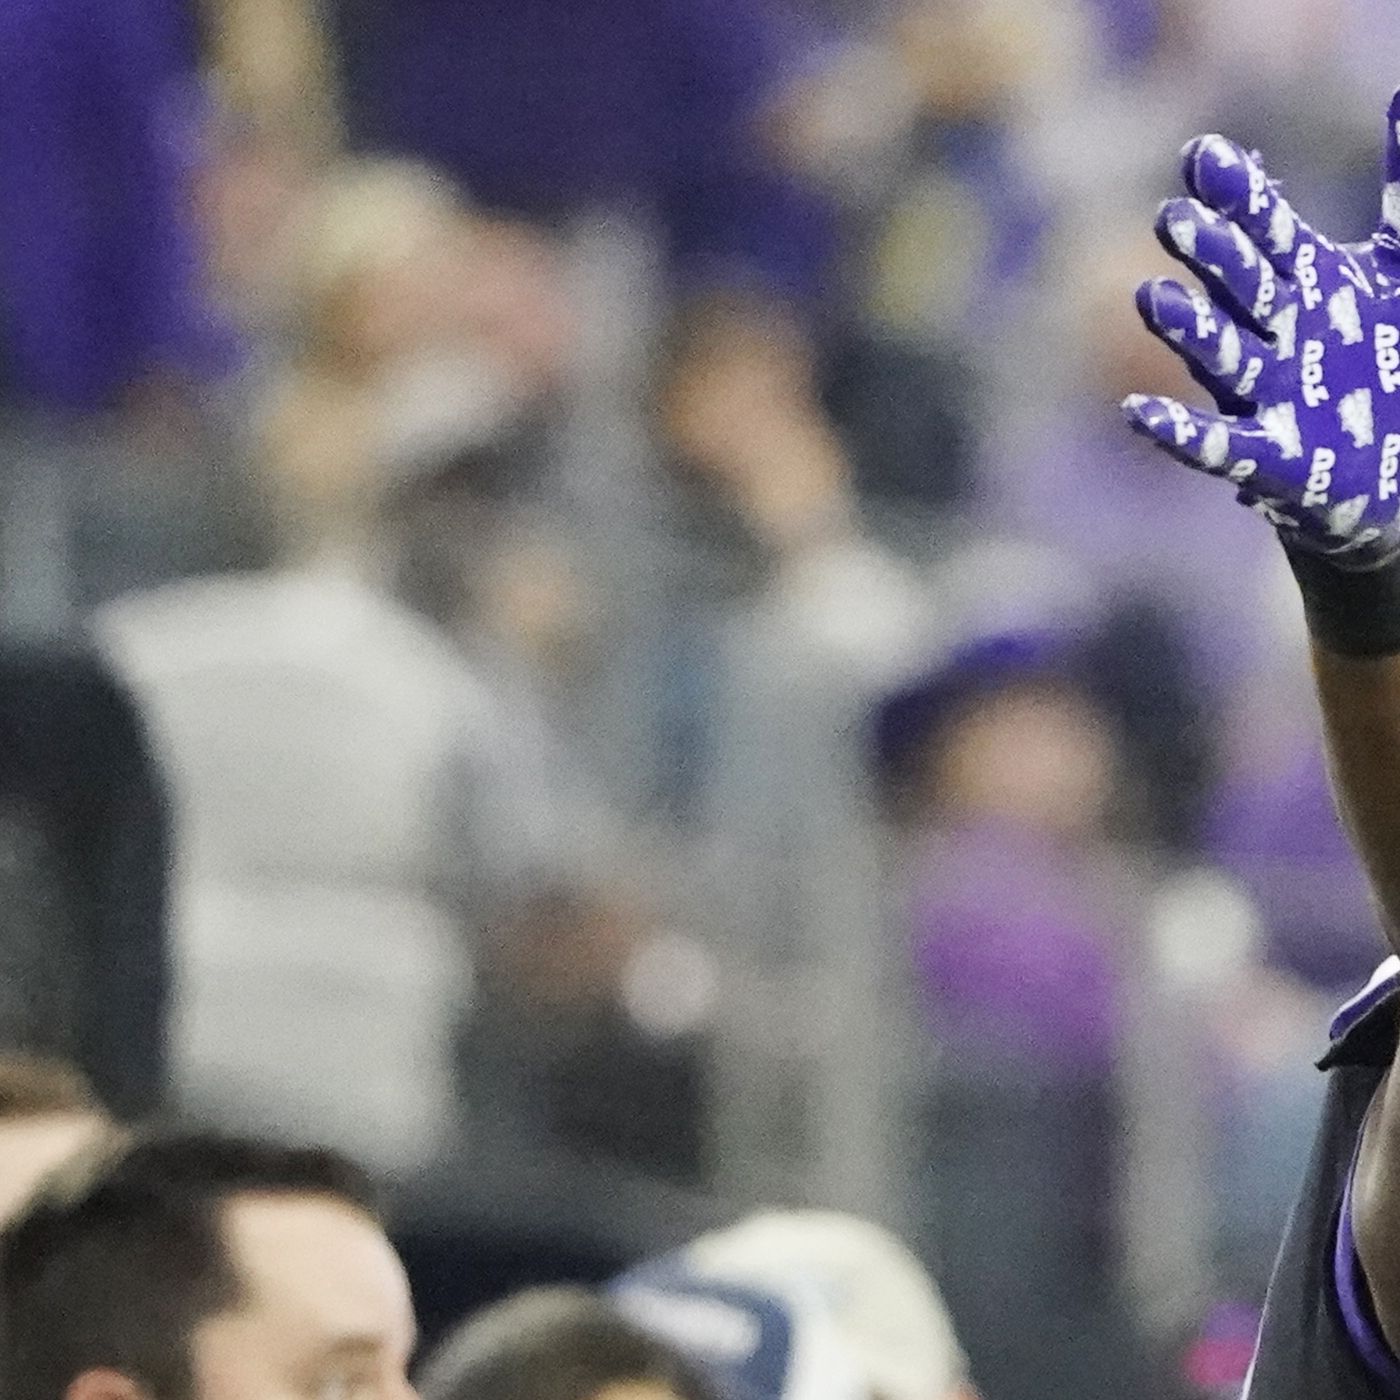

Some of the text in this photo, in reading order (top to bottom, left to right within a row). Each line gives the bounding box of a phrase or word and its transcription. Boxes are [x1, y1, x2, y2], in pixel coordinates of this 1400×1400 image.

[1294, 243, 1323, 310] TCU
[1301, 340, 1330, 408] TCU
[1302, 447, 1336, 508] TCU
